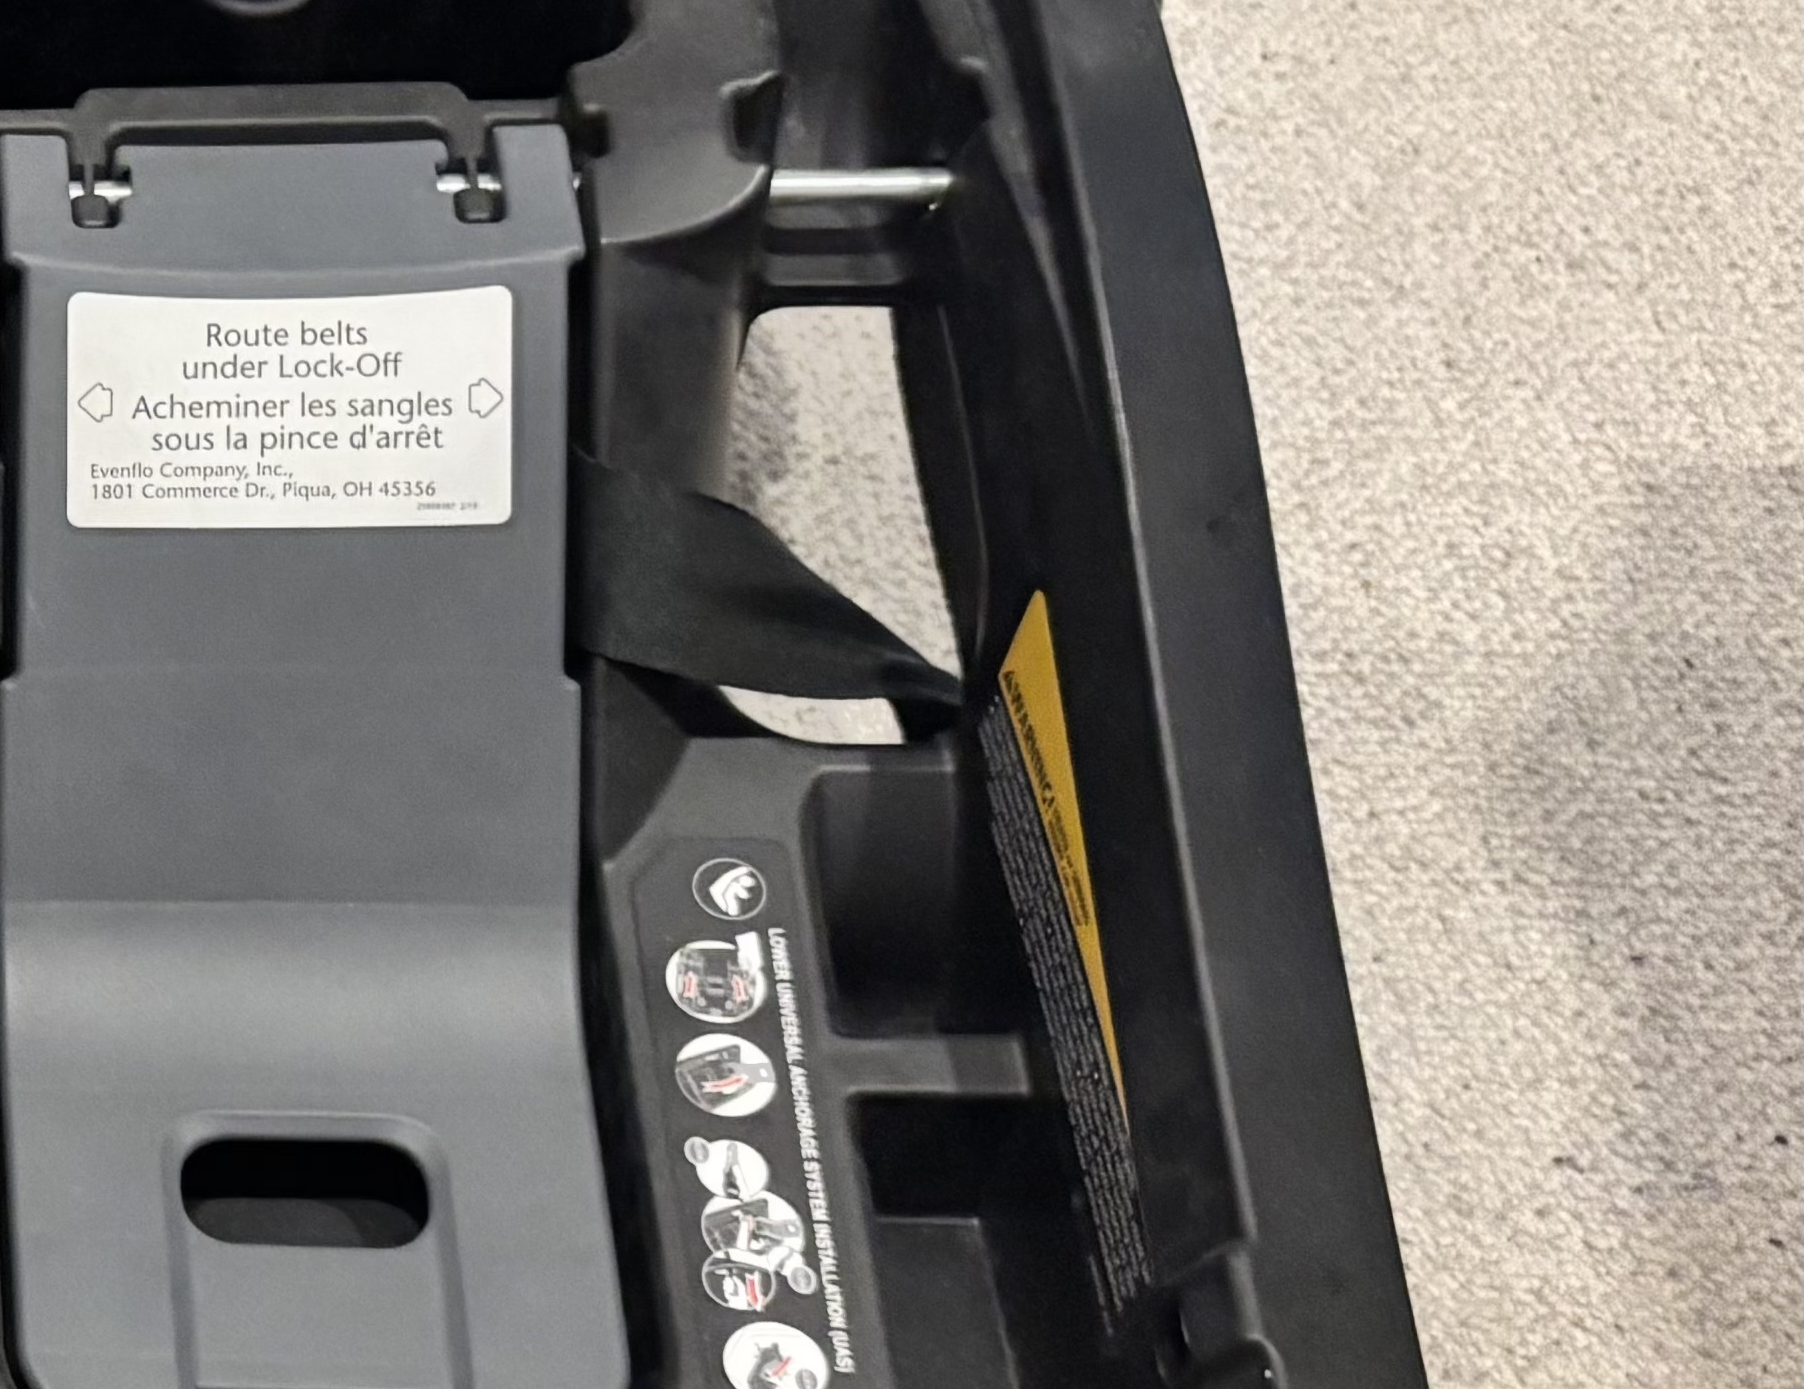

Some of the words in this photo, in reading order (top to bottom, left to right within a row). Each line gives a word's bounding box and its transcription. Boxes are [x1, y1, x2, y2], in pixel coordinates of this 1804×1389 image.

[206, 322, 289, 347] Route
[301, 320, 368, 346] belts
[183, 353, 269, 380] under
[279, 351, 403, 378] Lock-Off
[132, 393, 290, 419] Acheminer
[301, 391, 337, 417] les
[346, 391, 453, 424] sangles
[151, 432, 214, 451] sous
[226, 425, 248, 451] la
[260, 425, 338, 458] pince
[349, 423, 445, 450] d'arrêt
[90, 462, 153, 479] Evenflo
[160, 461, 249, 481] Company,
[256, 461, 293, 479] Inc.,
[92, 483, 132, 499] 1801
[142, 483, 239, 499] Commerce
[245, 482, 275, 500] Dr.,
[283, 481, 336, 501] Piqua,
[343, 481, 372, 497] OH
[379, 480, 436, 497] 45356
[768, 928, 791, 985] LOWER
[776, 983, 803, 1063] UNIVERSAL
[789, 1065, 819, 1159] ANCHORAGE
[803, 1161, 830, 1221] SYSTEM
[813, 1223, 847, 1329] INSTALLATION
[830, 1330, 855, 1373] (UAS)
